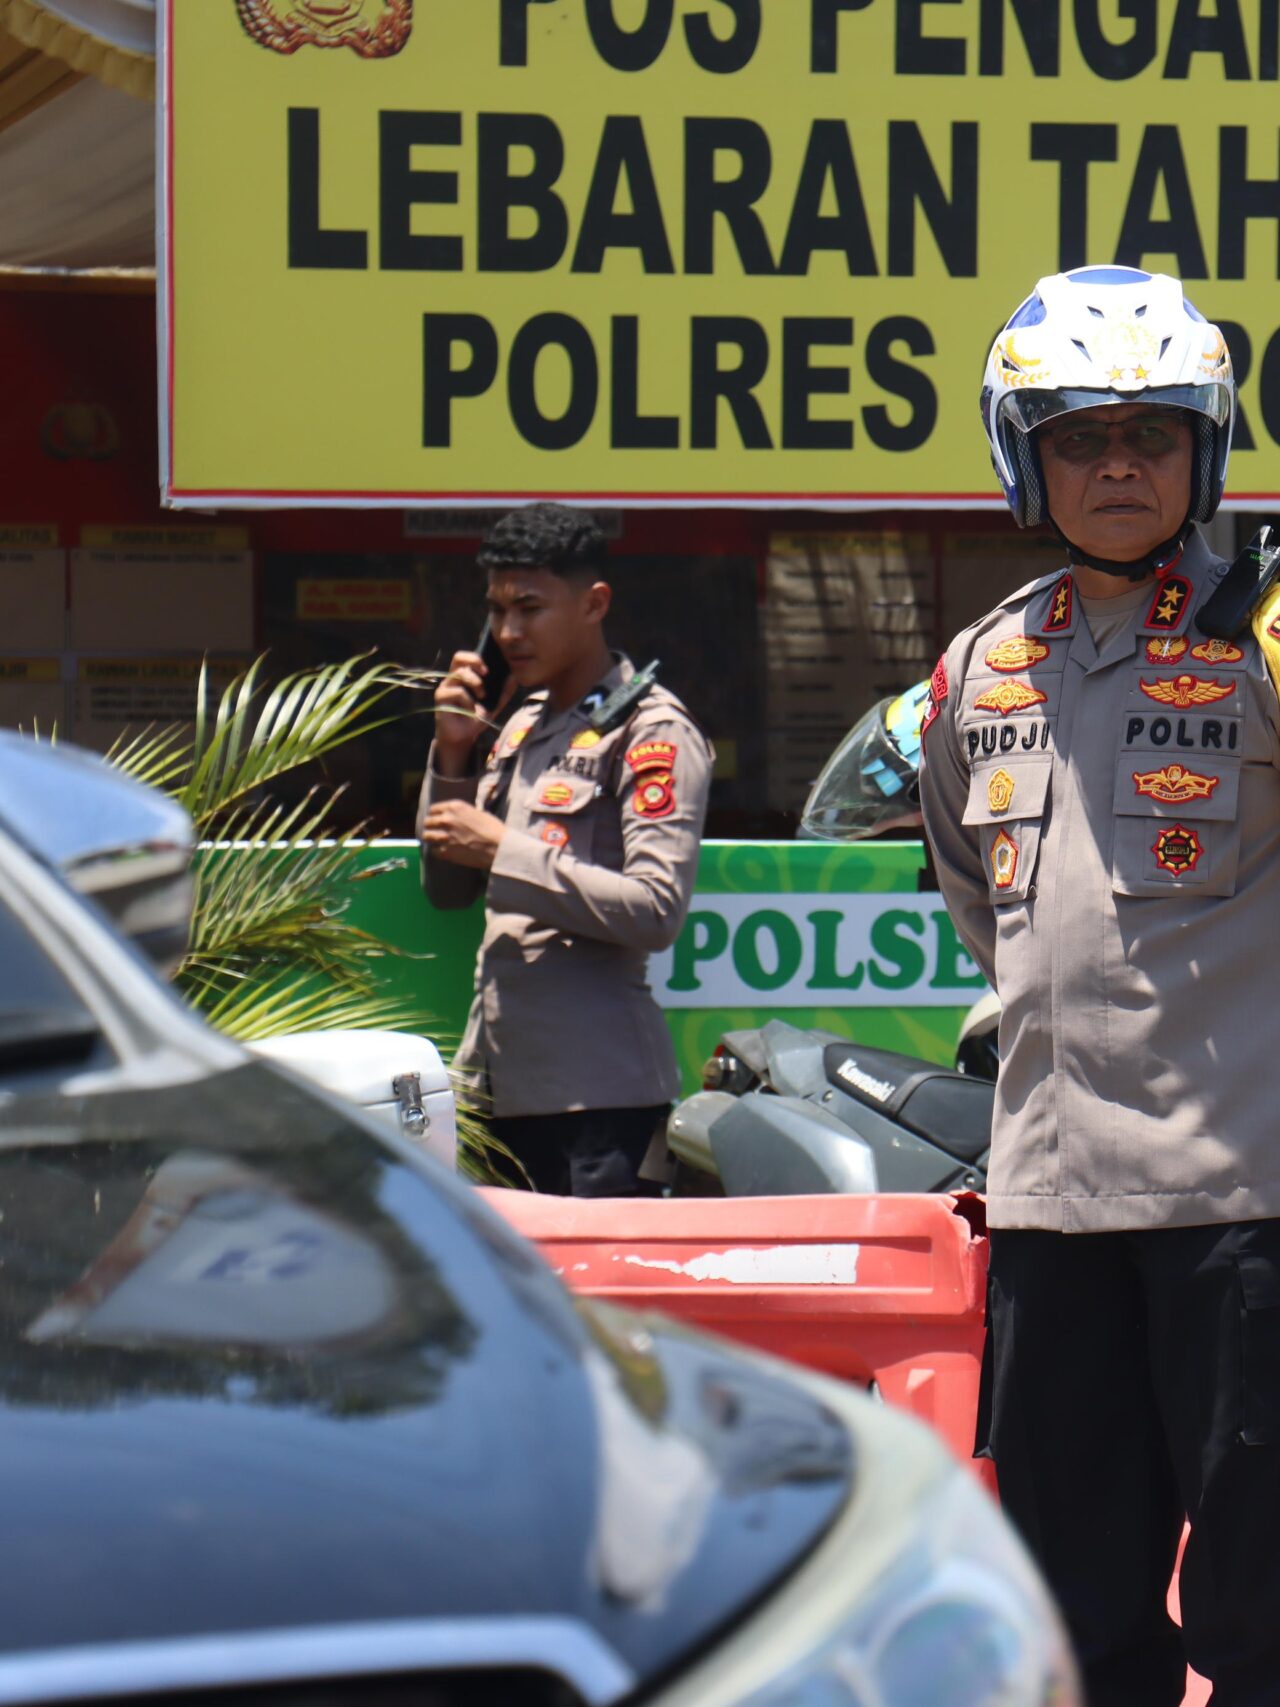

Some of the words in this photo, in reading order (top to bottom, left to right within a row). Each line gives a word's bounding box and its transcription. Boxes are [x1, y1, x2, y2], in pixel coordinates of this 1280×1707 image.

[500, 0, 762, 75] POS
[288, 107, 979, 278] LEBARAN
[423, 311, 938, 452] POLRES
[967, 722, 1051, 758] PUDJI
[1126, 717, 1238, 749] POLRI
[666, 908, 987, 991] POLSE
[836, 1057, 897, 1103] Kawasaki
